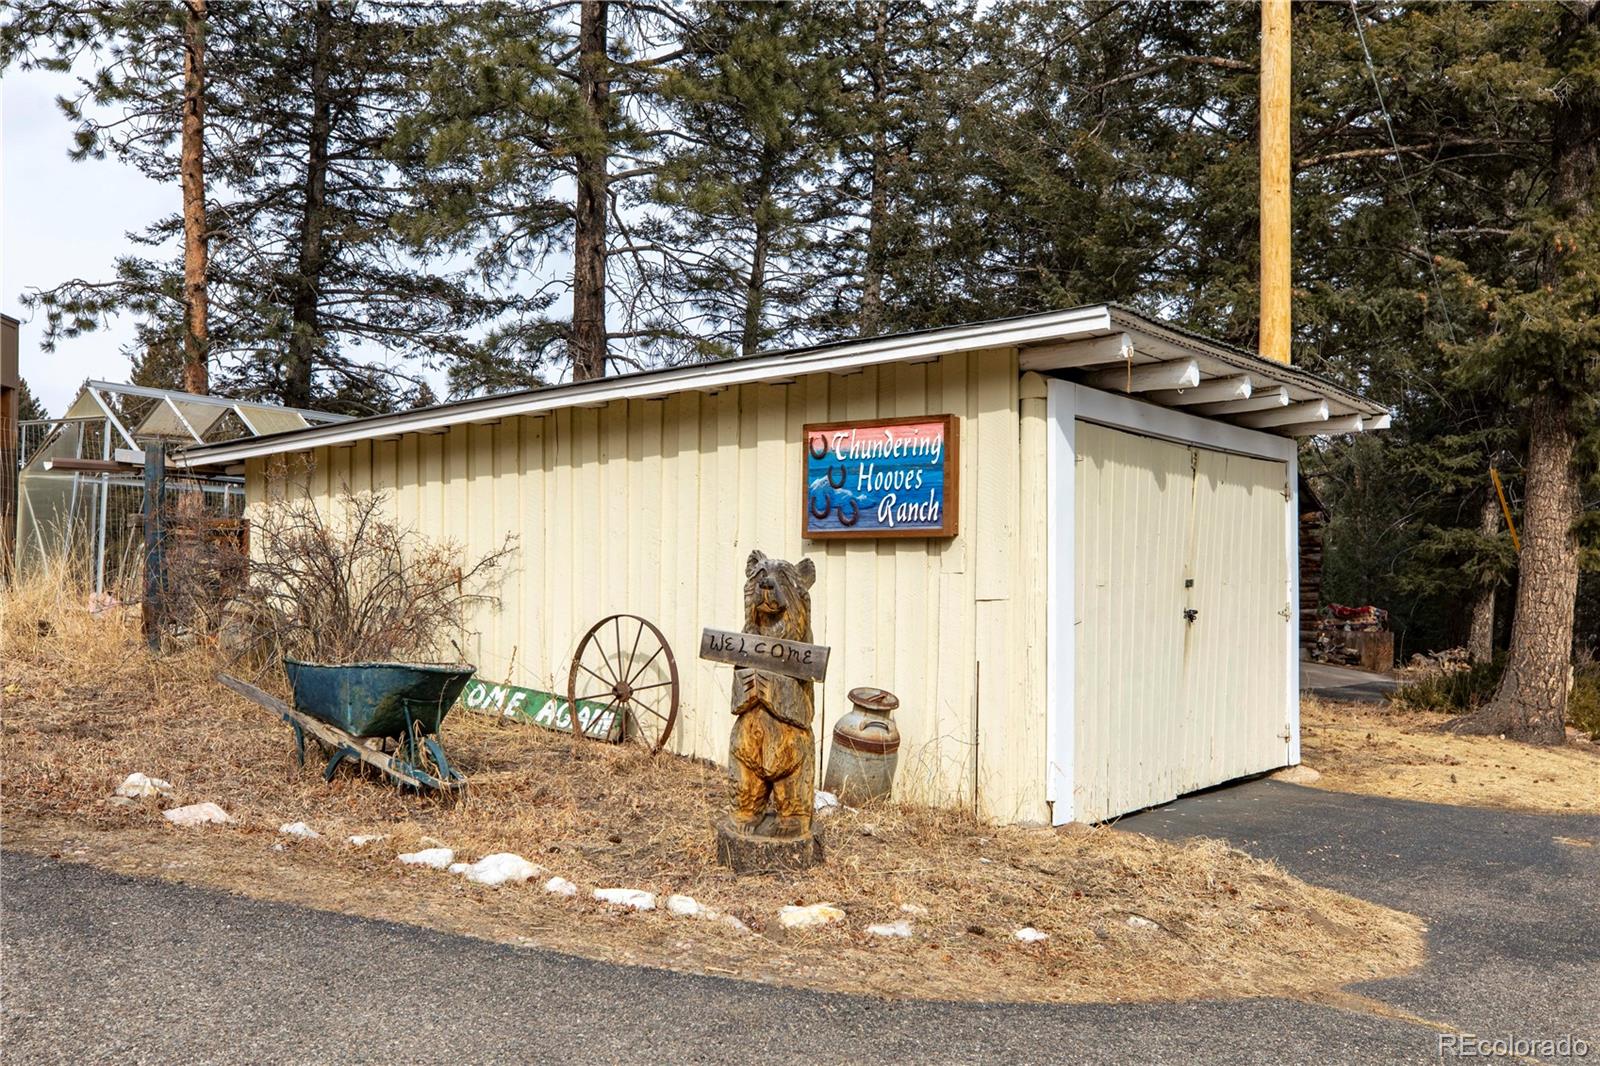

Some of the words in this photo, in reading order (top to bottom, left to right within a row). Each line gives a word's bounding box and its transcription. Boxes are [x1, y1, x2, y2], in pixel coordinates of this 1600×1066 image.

[832, 429, 942, 464] Thundering
[857, 462, 923, 491] Hooves
[878, 488, 939, 527] Ranch
[710, 634, 813, 664] WELCOME
[465, 681, 526, 716] OME
